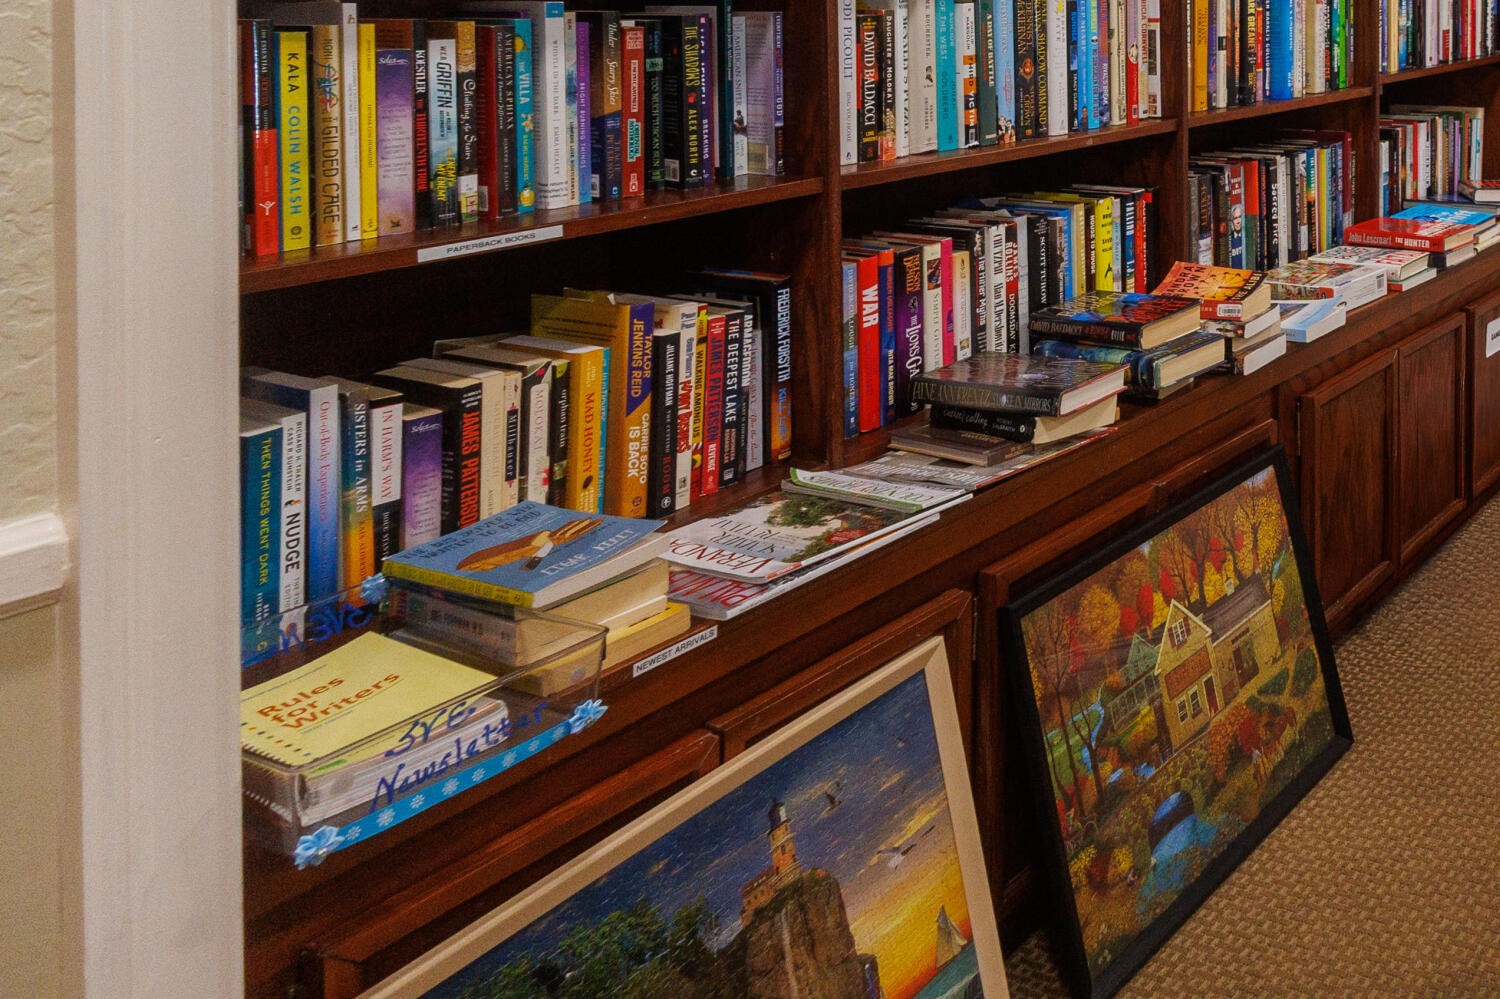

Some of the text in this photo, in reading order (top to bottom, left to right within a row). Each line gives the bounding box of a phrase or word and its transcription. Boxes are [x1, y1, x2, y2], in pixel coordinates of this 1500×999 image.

[939, 16, 947, 32] THE
[939, 36, 947, 60] WEST
[986, 20, 995, 36] DAY
[986, 36, 995, 50] OF
[1140, 23, 1148, 65] CORNWELL
[415, 50, 426, 94] KOESTLER
[685, 26, 700, 87] THE SHADOWS
[843, 27, 853, 80] PICOULT
[864, 31, 876, 125] DAVID BALDACCI
[1037, 33, 1047, 124] SHADOW COMMAND
[437, 63, 453, 108] GRIFFIN
[288, 53, 302, 215] KALA COLIN WALSH
[688, 109, 697, 164] ALEX NORTH
[321, 126, 339, 224] GILDED CAGE
[446, 157, 455, 181] ENEMY
[446, 233, 536, 254] PAPERBACK BOOKS
[862, 284, 879, 328] WAR
[631, 318, 643, 398] JENKINS REID
[643, 334, 653, 378] TAYLOR
[778, 288, 790, 382] FREDERICK FORSYTH
[664, 344, 675, 406] JILLIANE HOFFMAN
[696, 350, 704, 391] WALKING
[725, 320, 740, 424] THE DEEPEST LAKE
[887, 349, 895, 405] RITA MAE BROWN
[558, 389, 568, 448] orphan train
[583, 393, 594, 473] MAD HONEY
[694, 393, 702, 424] AMONG
[353, 404, 367, 513] SISTERS in ARMS
[381, 410, 394, 499] IN HARM'S WAY
[627, 426, 639, 478] IS BACK
[640, 413, 650, 484] CARRIE SOTO
[708, 443, 716, 471] REVENGE
[258, 438, 271, 586] THEN THINGS WENT DARK
[284, 513, 300, 573] NUDGE
[636, 629, 715, 673] NEWEST ARRIVALS
[257, 677, 345, 718] Rules
[271, 701, 320, 723] for
[282, 673, 401, 730] Writers
